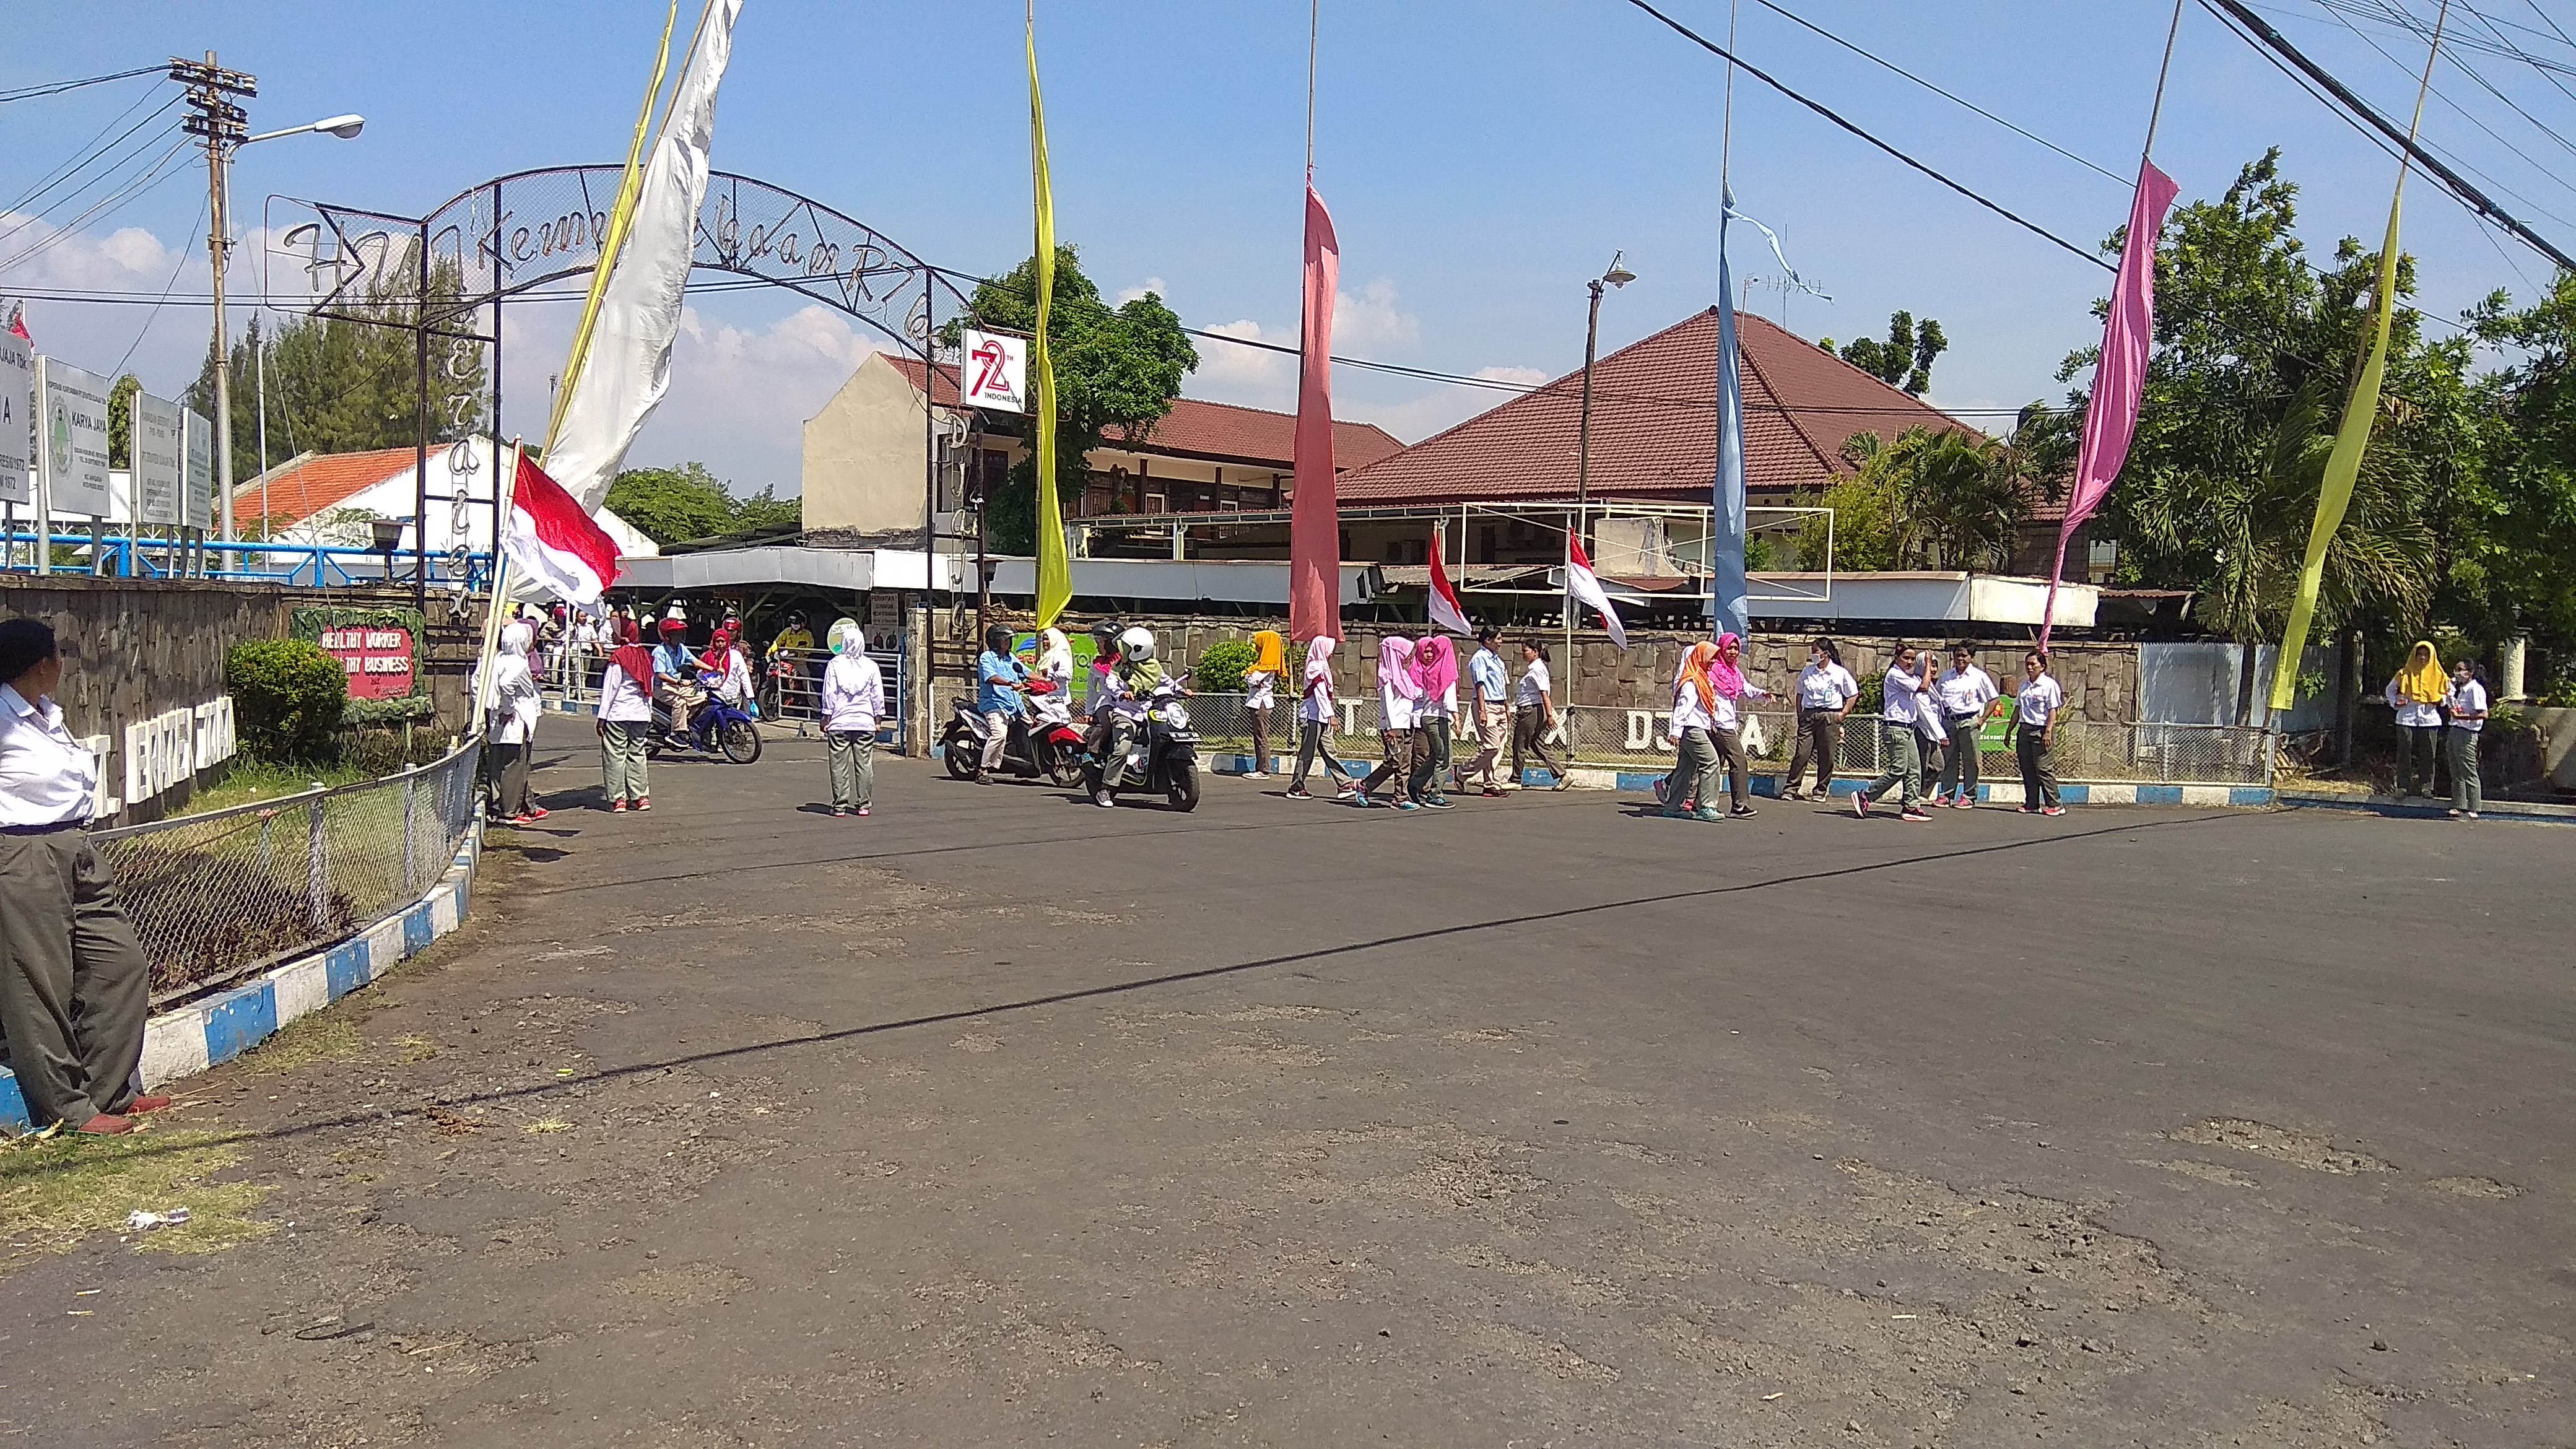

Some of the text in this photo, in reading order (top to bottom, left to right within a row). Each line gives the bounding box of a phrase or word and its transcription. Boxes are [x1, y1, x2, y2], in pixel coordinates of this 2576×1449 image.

[0, 346, 15, 366] JAJA
[970, 339, 1009, 396] 72
[984, 391, 1023, 404] INDONESIA
[71, 411, 107, 435] KARYA JAYA
[321, 632, 401, 649] HEALTHY WORKER
[364, 656, 409, 672] BUSINESS
[125, 708, 196, 804] ERATEX
